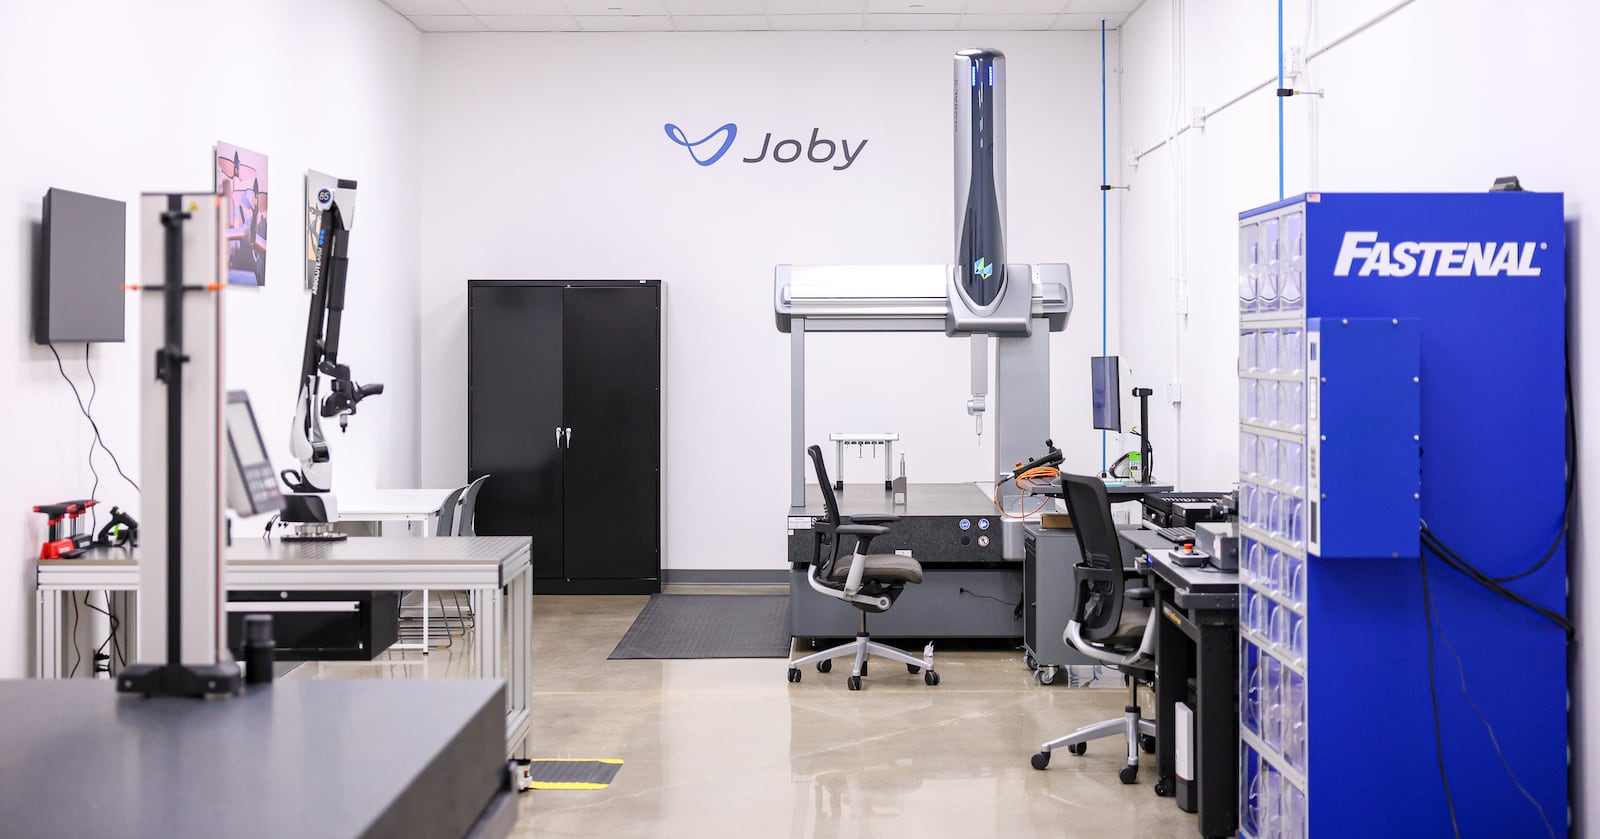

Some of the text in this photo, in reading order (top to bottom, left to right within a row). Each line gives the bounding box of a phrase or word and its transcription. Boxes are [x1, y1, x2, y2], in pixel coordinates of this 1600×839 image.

[743, 128, 869, 170] Joby
[319, 191, 330, 201] 85
[1333, 231, 1542, 277] FASTENAL
